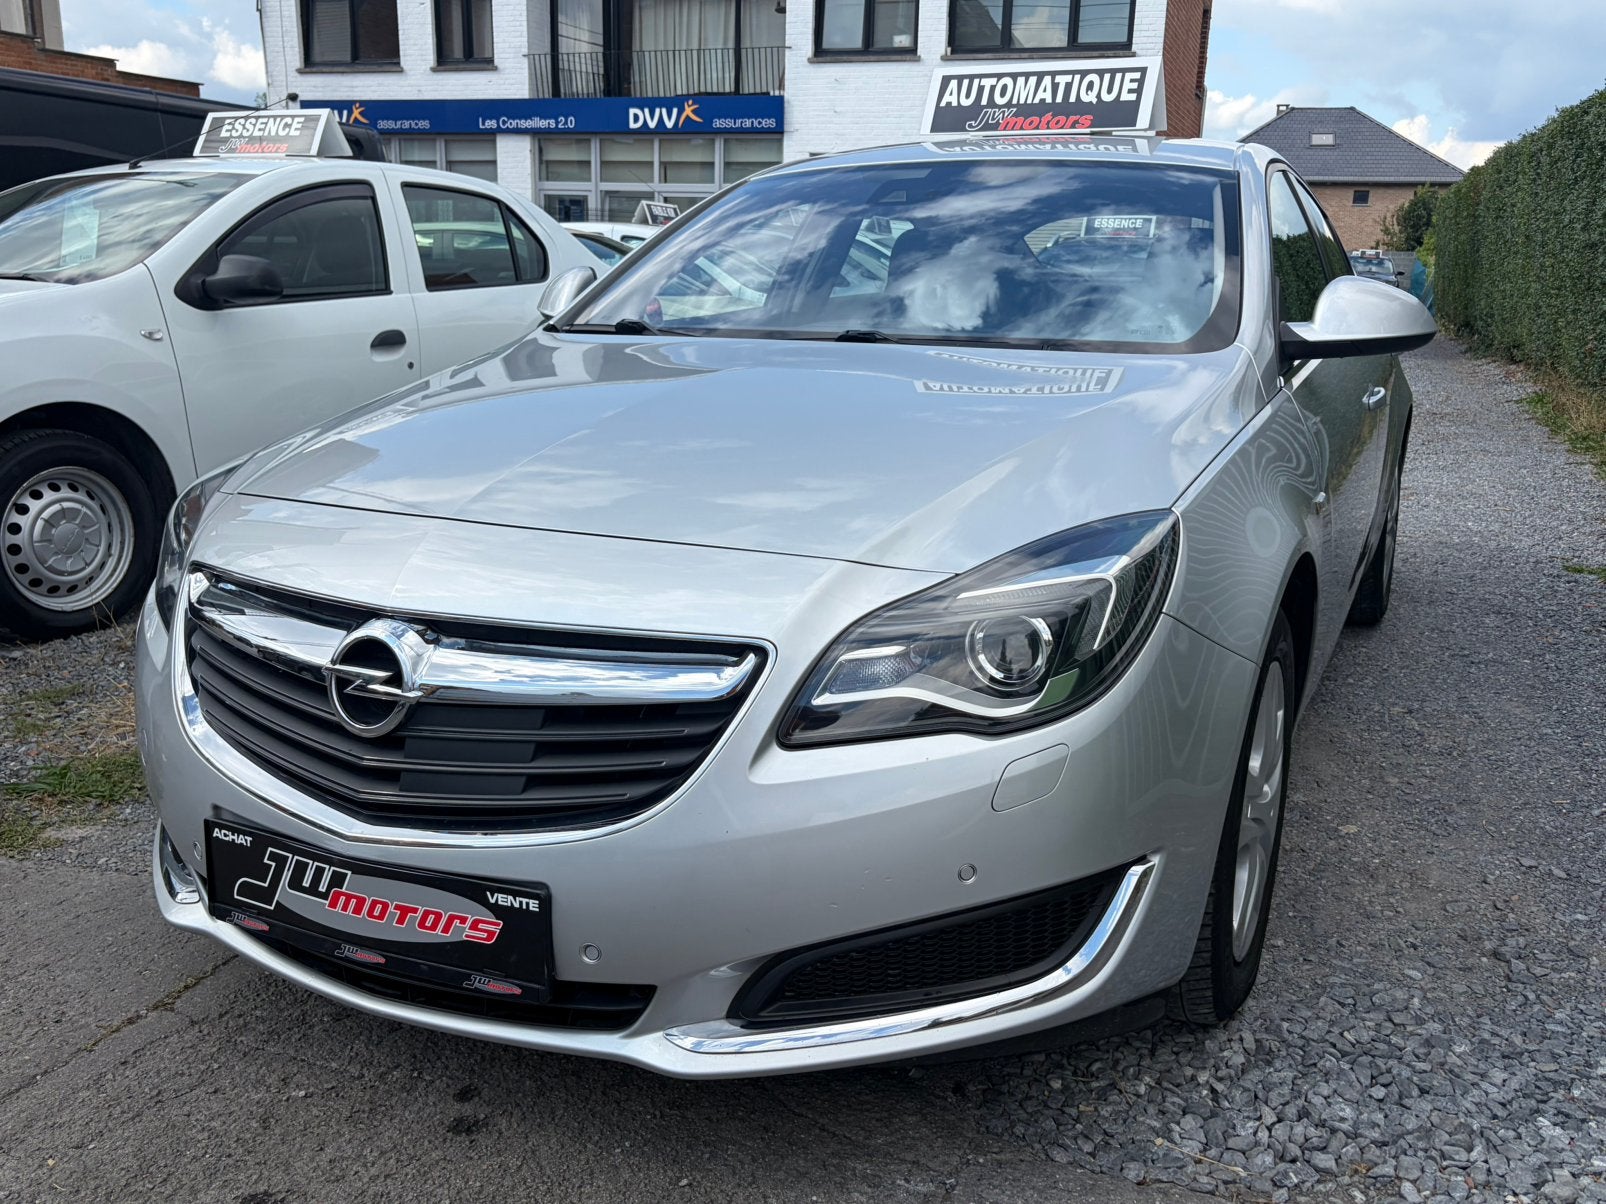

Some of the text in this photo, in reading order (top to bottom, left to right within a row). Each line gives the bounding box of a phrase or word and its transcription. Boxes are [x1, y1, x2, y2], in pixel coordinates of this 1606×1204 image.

[939, 71, 1142, 107] AUTOMATIQUE
[220, 116, 304, 137] ESSENCE
[376, 118, 431, 130] assurances
[478, 117, 575, 129] Les Conseillers 2.0
[712, 117, 776, 128] assurances
[998, 112, 1094, 131] motors
[236, 142, 288, 153] motors
[1094, 218, 1144, 229] ESSENCE
[212, 827, 253, 847] ACHAT
[486, 891, 540, 912] VENTE
